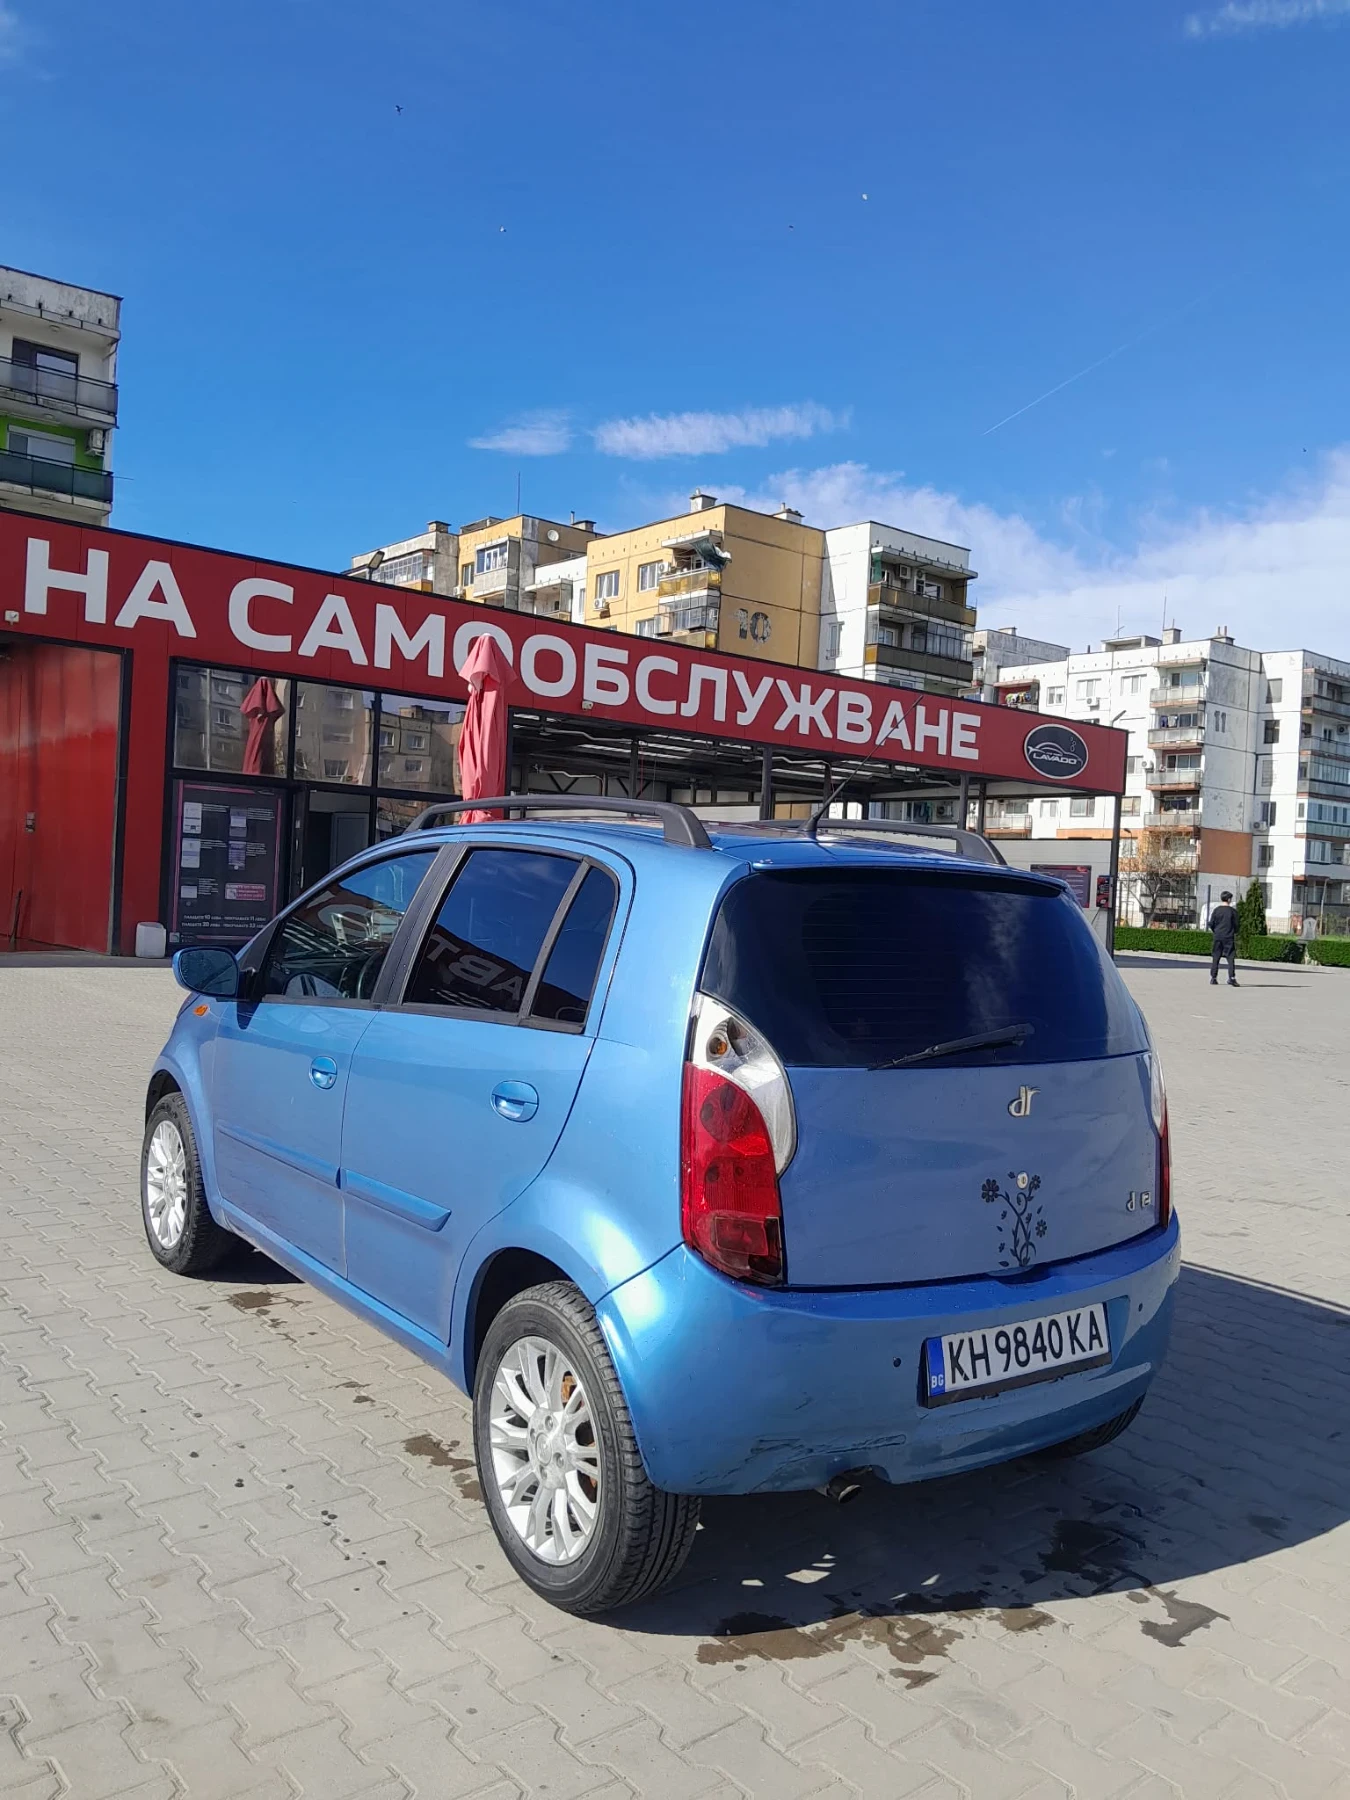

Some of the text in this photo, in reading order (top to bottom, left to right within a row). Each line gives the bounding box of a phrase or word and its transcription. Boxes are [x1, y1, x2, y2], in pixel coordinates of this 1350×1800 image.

[733, 608, 772, 643] 10
[24, 537, 982, 761] НА САМООБСЛУЖВАНЕ
[1032, 752, 1078, 765] LAVADO
[1008, 1085, 1041, 1117] dr
[931, 1374, 945, 1389] BG
